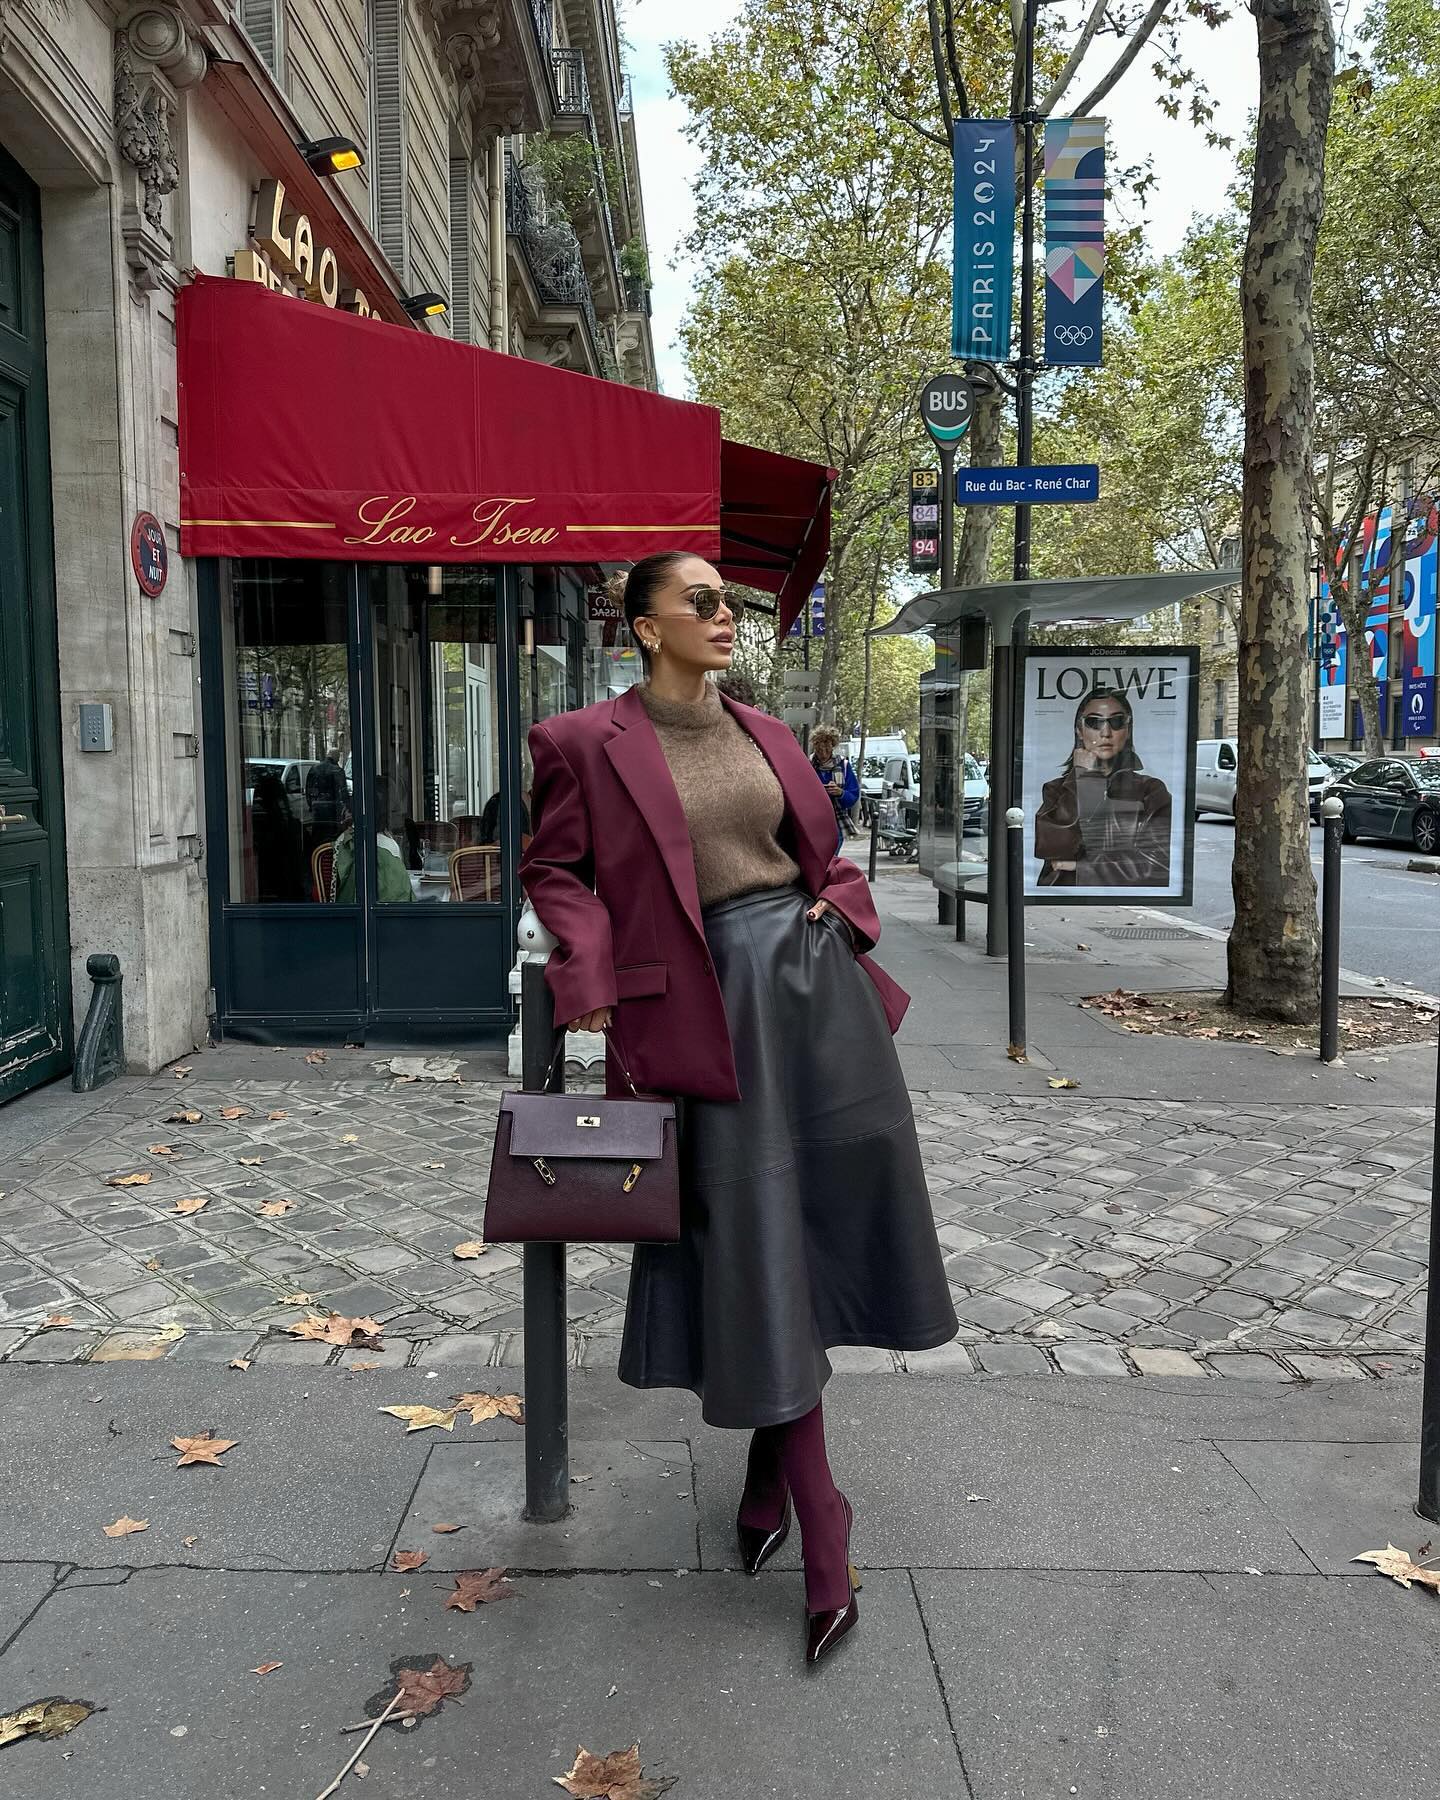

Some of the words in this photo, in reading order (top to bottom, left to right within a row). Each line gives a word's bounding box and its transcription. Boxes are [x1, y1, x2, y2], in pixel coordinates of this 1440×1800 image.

[973, 138, 996, 225] 2024
[271, 179, 339, 309] LAO
[929, 390, 968, 412] BUS
[915, 473, 934, 487] 83
[965, 480, 986, 492] Rue
[989, 479, 1003, 491] du
[1005, 479, 1026, 491] Bac
[1035, 477, 1062, 490] René
[1065, 477, 1091, 490] Char
[343, 496, 437, 545] Lao
[450, 497, 560, 547] Tseu
[915, 506, 935, 521] 84
[148, 529, 162, 545] JOUR
[152, 548, 160, 561] ET
[915, 540, 935, 554] 94
[149, 565, 162, 581] NUIT
[1089, 648, 1127, 656] JCDecaux
[1036, 667, 1178, 700] LOEWE
